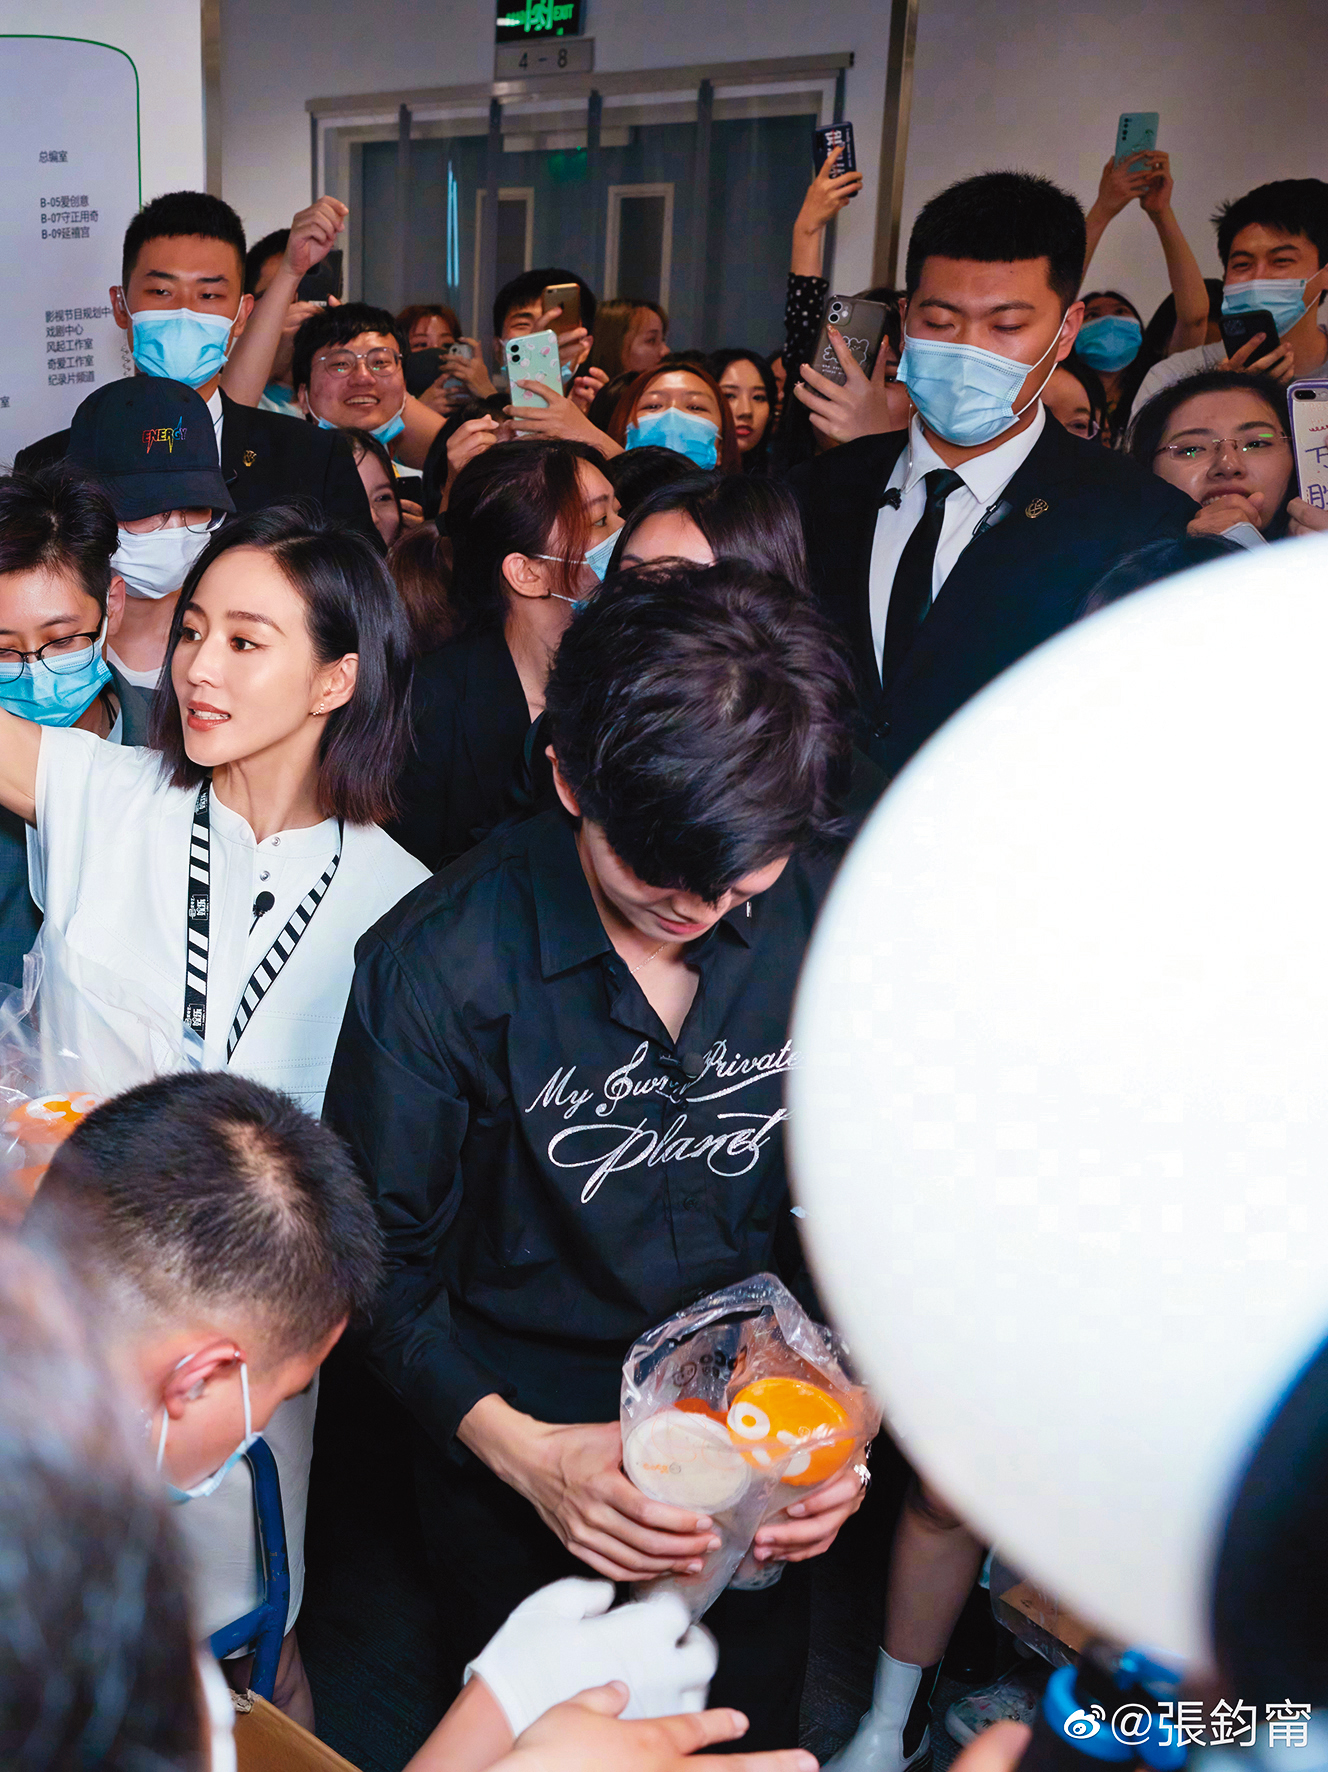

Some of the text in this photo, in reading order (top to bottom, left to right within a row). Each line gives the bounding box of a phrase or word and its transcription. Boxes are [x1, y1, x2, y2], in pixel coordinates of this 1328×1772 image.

[45, 306, 114, 323] 影视节目规划中
[46, 323, 84, 338] 戏剧中心
[142, 415, 188, 454] ENERGY
[525, 1065, 594, 1119] My
[680, 1038, 803, 1096] Private
